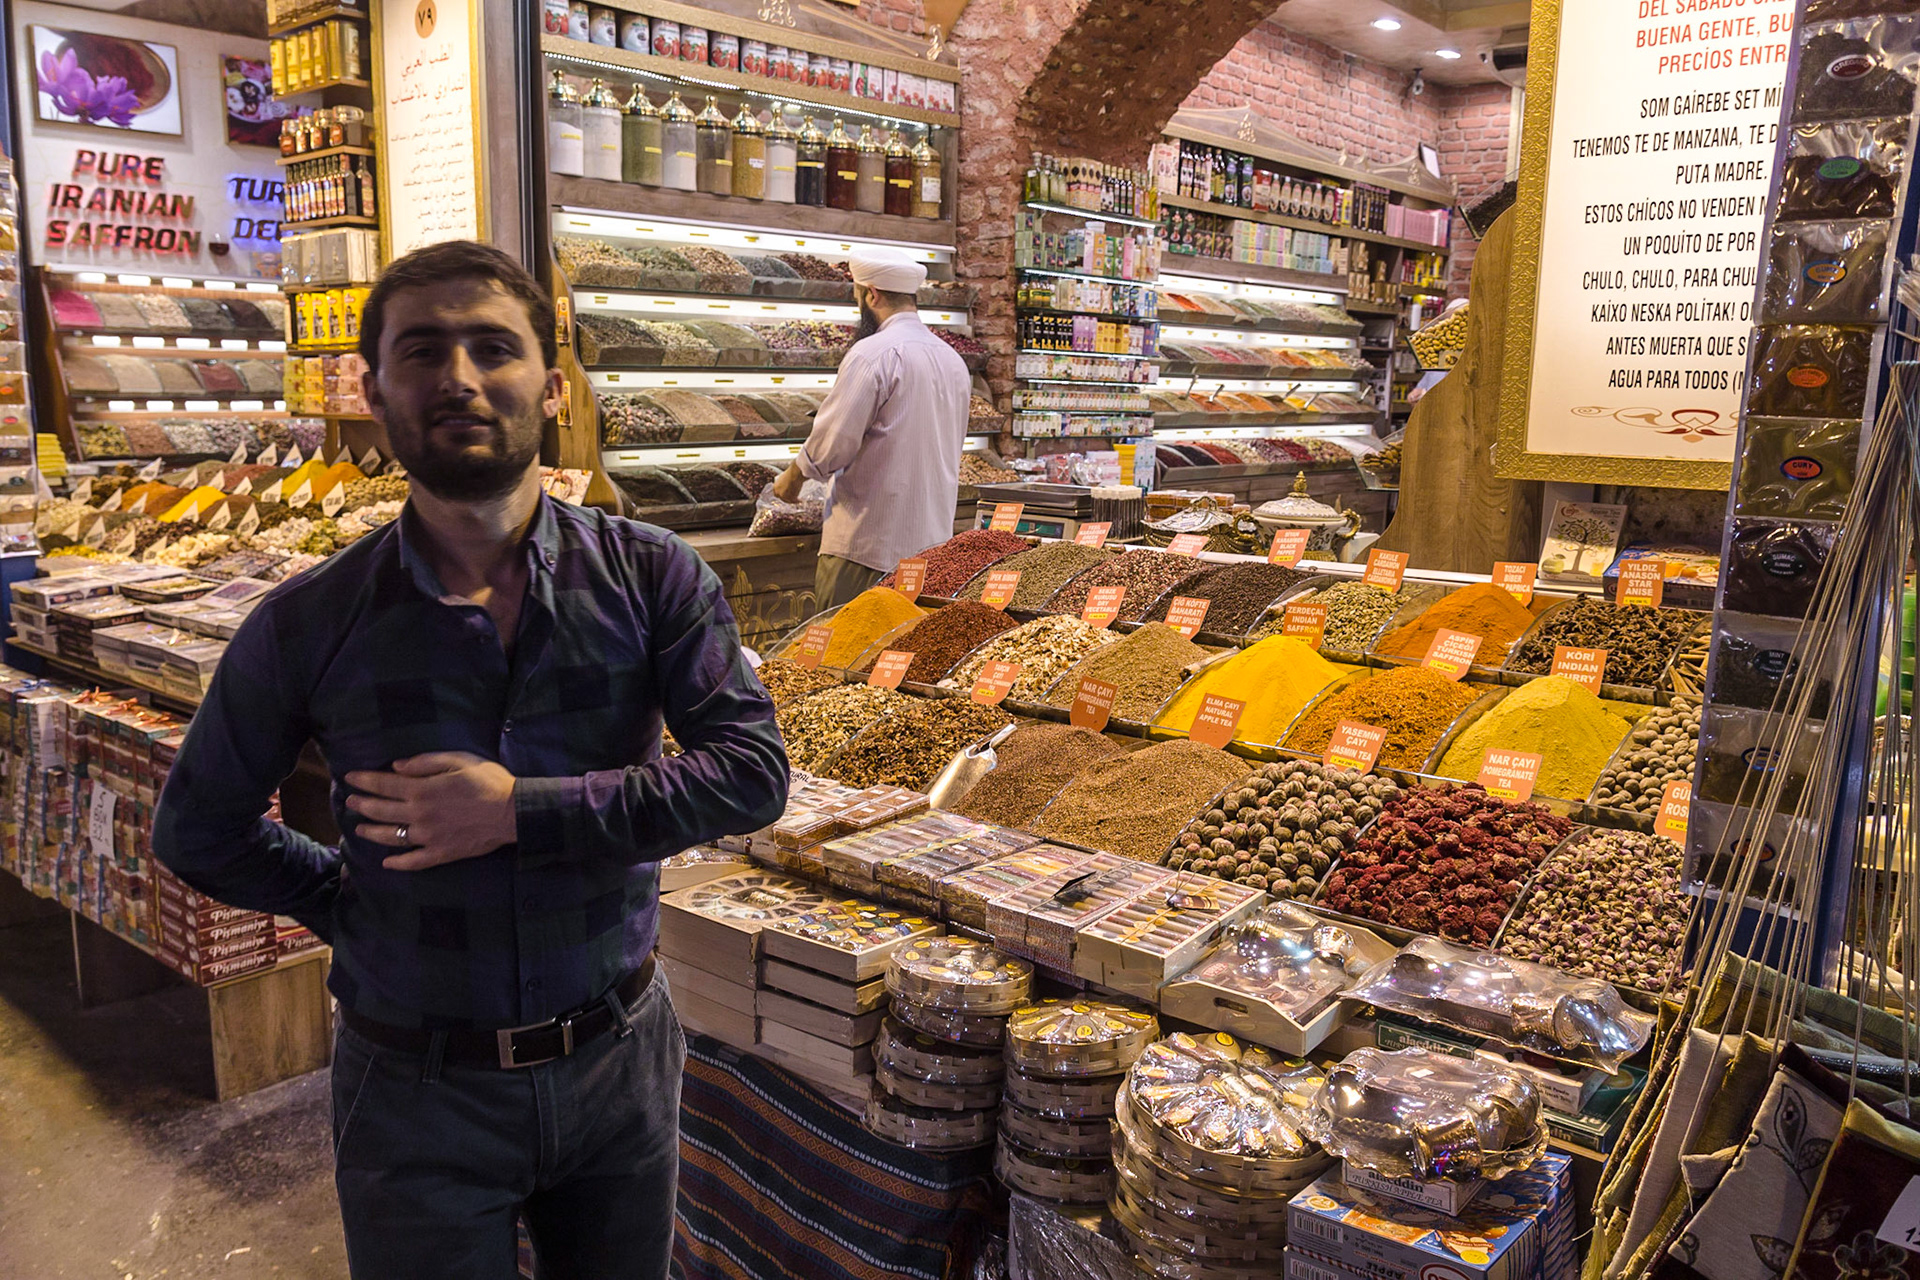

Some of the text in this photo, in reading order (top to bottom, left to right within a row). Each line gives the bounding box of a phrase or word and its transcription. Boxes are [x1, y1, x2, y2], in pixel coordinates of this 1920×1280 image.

[1636, 24, 1692, 48] BUENA
[1699, 16, 1761, 41] GENTE,
[1739, 44, 1790, 66] ENTR
[1640, 97, 1670, 119] SOM
[1734, 89, 1761, 111] SET
[1573, 135, 1630, 158] TENEMOS
[1635, 133, 1650, 153] TE
[1653, 132, 1670, 152] DE
[1673, 126, 1743, 150] MANZANA,
[1750, 124, 1765, 144] TE
[75, 149, 164, 183] PURE
[1676, 160, 1767, 185] PUTA MADRE.
[51, 183, 195, 219] IRANIAN
[1585, 203, 1623, 224] ESTOS
[1678, 199, 1697, 220] NO
[1702, 196, 1756, 218] VENDEN
[46, 220, 202, 252] SAFFRON
[1624, 236, 1641, 256] UN
[1706, 233, 1724, 252] DE
[1727, 231, 1756, 251] POR
[1583, 270, 1628, 292] CHULO,
[1632, 269, 1678, 291] CHULO,
[1683, 267, 1718, 288] PARA
[1631, 302, 1672, 322] NESKA
[1606, 336, 1646, 355] ANTES
[1650, 336, 1702, 356] MUERTA
[1707, 336, 1734, 356] QUE
[1608, 369, 1642, 389] AGUA
[1646, 370, 1680, 389] PARA
[1684, 370, 1729, 390] TODOS
[1621, 571, 1661, 580] ANASON
[1627, 563, 1658, 572] YILDIZ
[1625, 588, 1653, 596] ANISE
[1628, 580, 1652, 588] STAR
[1287, 606, 1325, 616] ZERDEÇAL
[1168, 615, 1201, 626] MEAT SPICES
[1291, 616, 1318, 625] INDIAN
[1286, 624, 1320, 634] SAFFRON
[1432, 651, 1473, 666] SAFFRON
[1557, 662, 1599, 673] INDIAN
[1082, 681, 1114, 698] NAR ÇAYI
[1085, 705, 1096, 715] TEA
[1206, 698, 1240, 711] ELMA ÇAYI
[1198, 714, 1233, 728] APPLE TEA
[1204, 707, 1234, 719] NATURAL
[1341, 725, 1381, 742] YASEMİN
[1345, 736, 1368, 748] ÇAYI
[1330, 745, 1372, 762] JASMIN TEA
[1488, 754, 1536, 770] NAR ÇAYI
[1482, 765, 1535, 781] POMEGRANATE
[1498, 778, 1512, 789] TEA
[1665, 803, 1689, 818] ROS
[1352, 1174, 1443, 1207] TURKISH APPLE TEA
